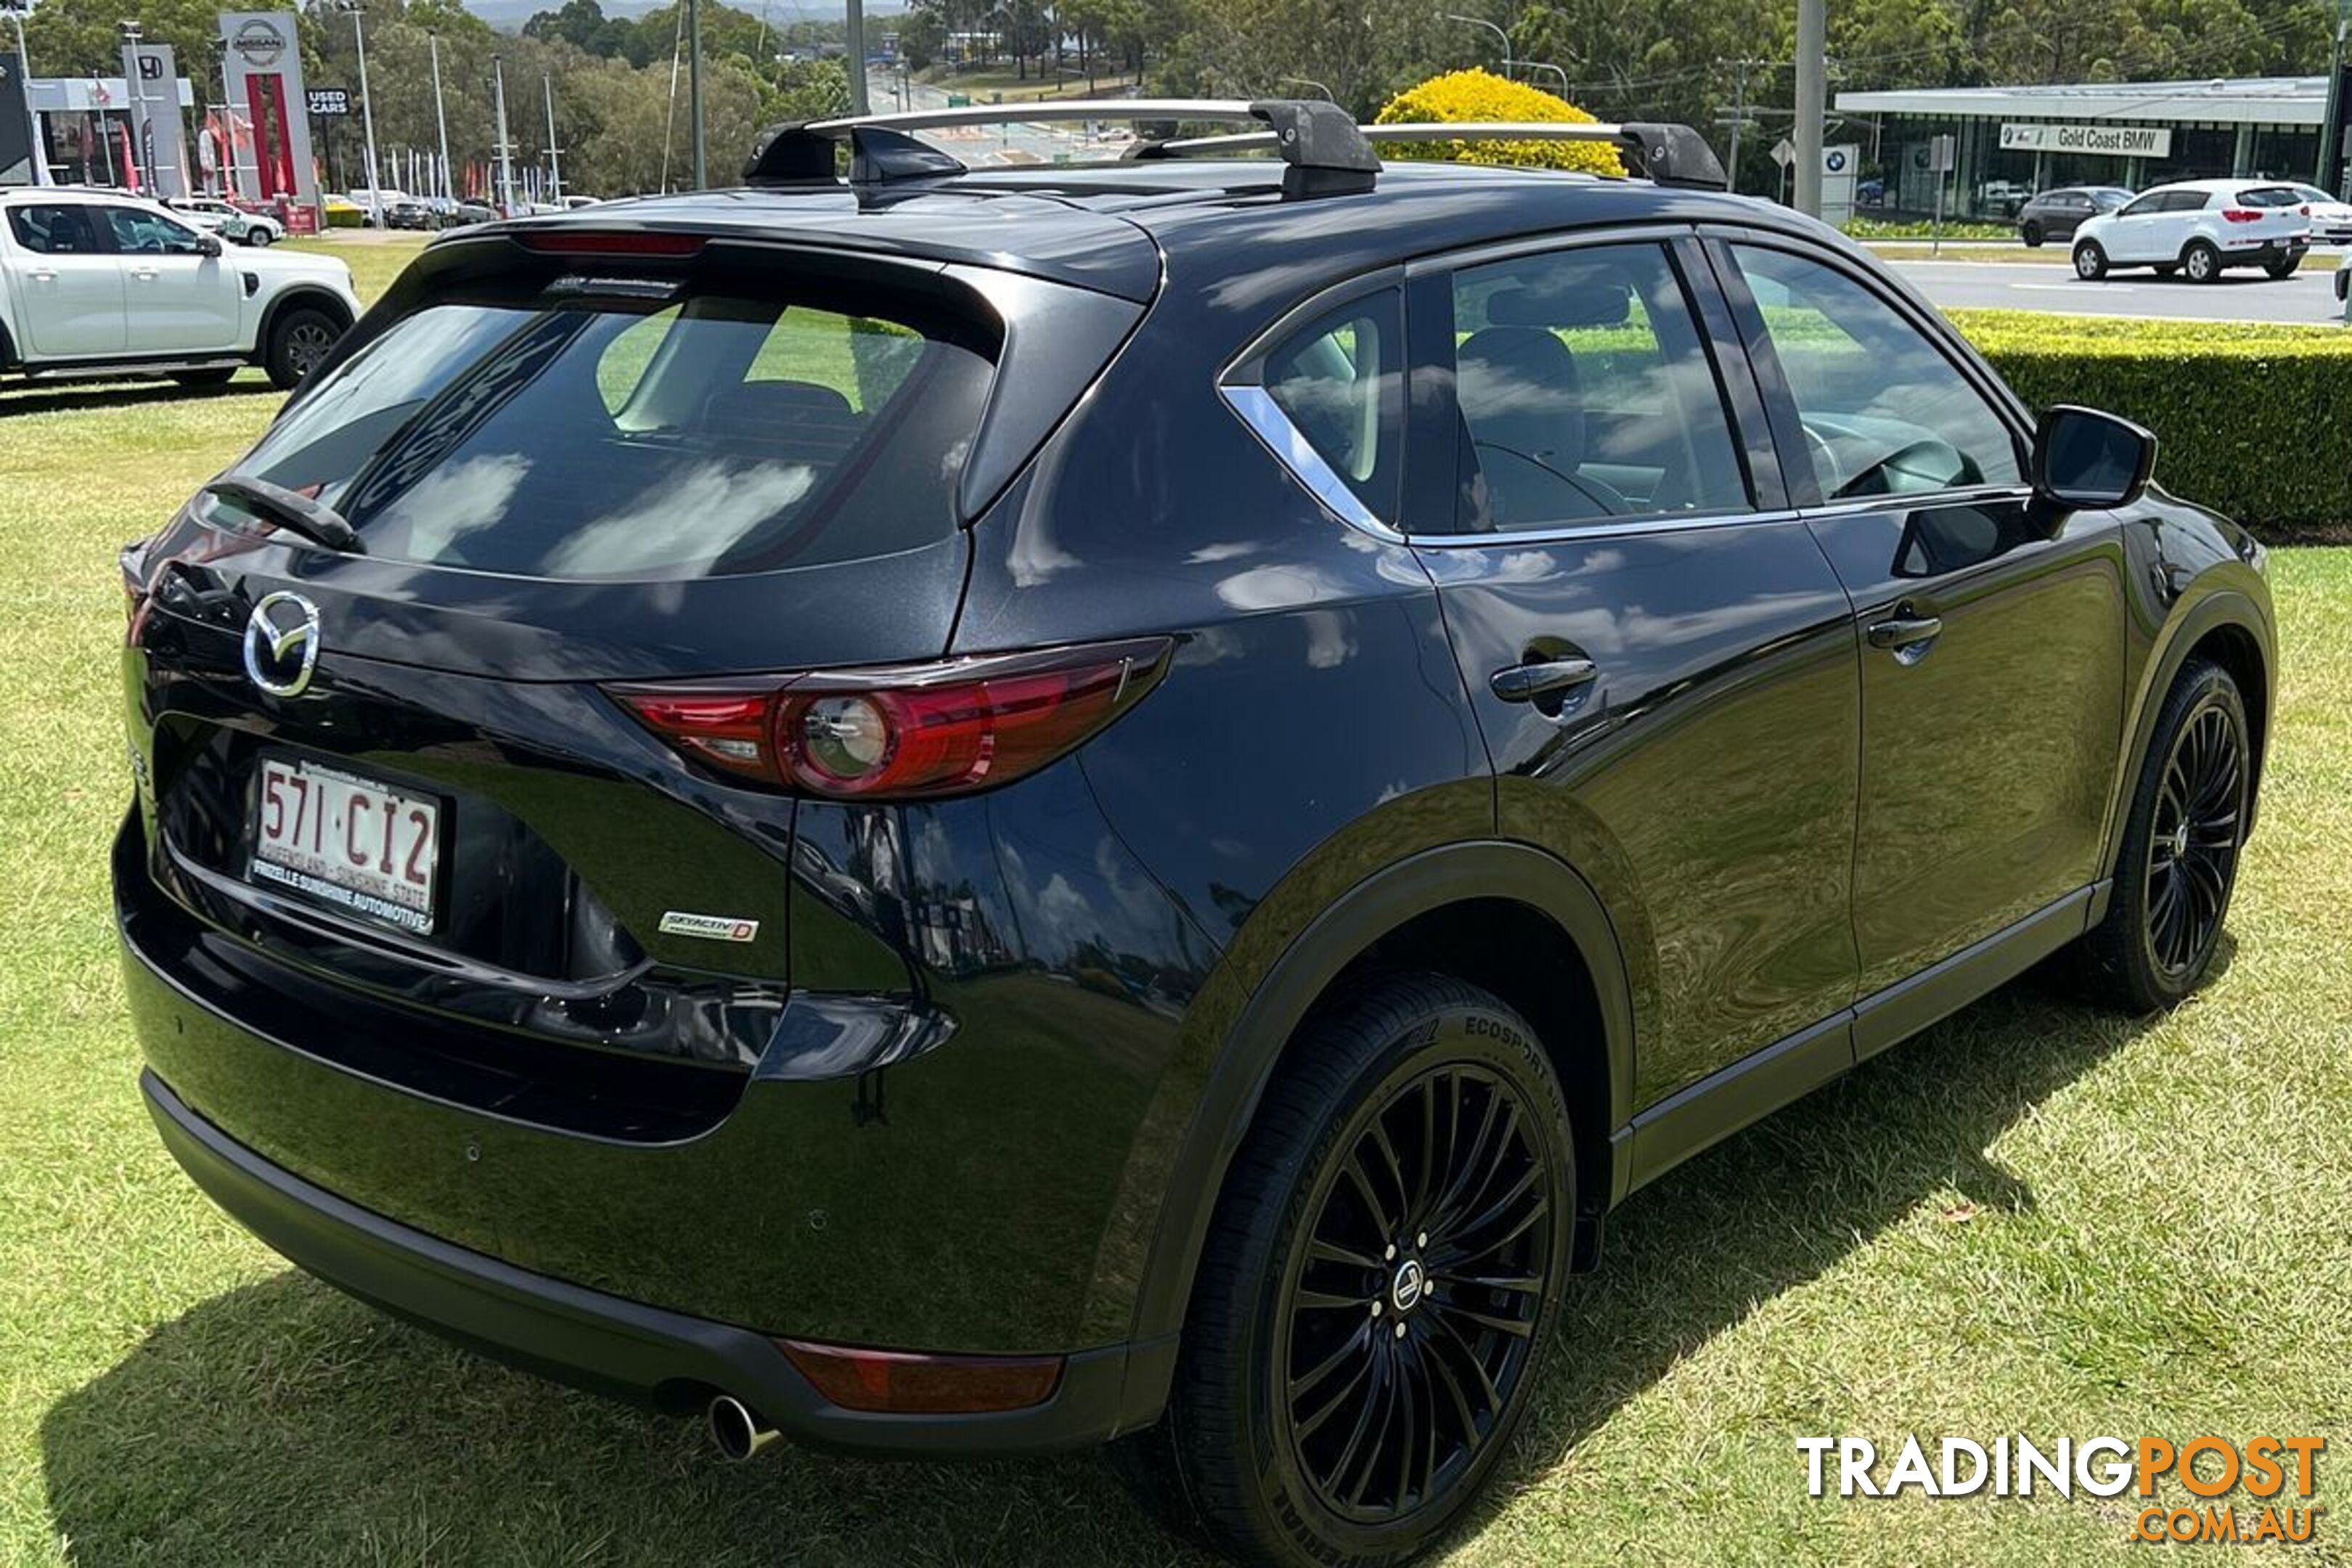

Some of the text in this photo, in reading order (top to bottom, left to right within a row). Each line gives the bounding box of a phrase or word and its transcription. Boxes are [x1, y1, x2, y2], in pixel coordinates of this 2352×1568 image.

[309, 91, 346, 102] USED
[311, 102, 347, 113] CARS
[2058, 128, 2156, 150] Gold Coast BMW
[266, 770, 324, 852] 571
[337, 866, 388, 898] SUNSHINE
[393, 883, 425, 910] STATE
[353, 893, 427, 930] AUTOMOTIVE
[669, 915, 732, 929] SKYACTIV
[1465, 1016, 1548, 1080] ECOSPORT
